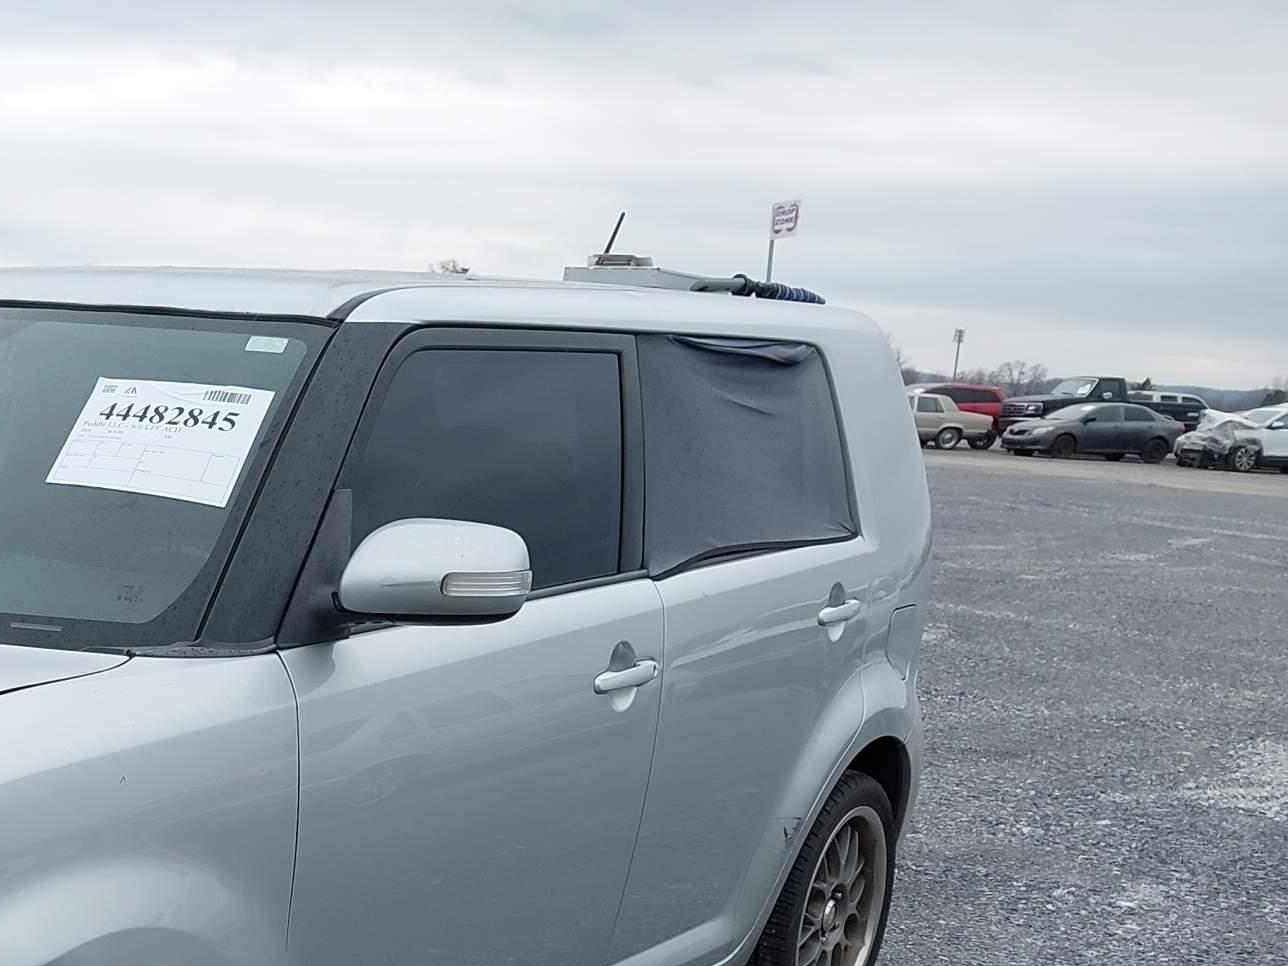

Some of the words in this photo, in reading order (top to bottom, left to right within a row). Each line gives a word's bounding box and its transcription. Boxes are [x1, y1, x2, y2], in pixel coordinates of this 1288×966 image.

[776, 208, 795, 217] DROP
[775, 217, 794, 226] ZONE
[99, 402, 241, 432] 44482845
